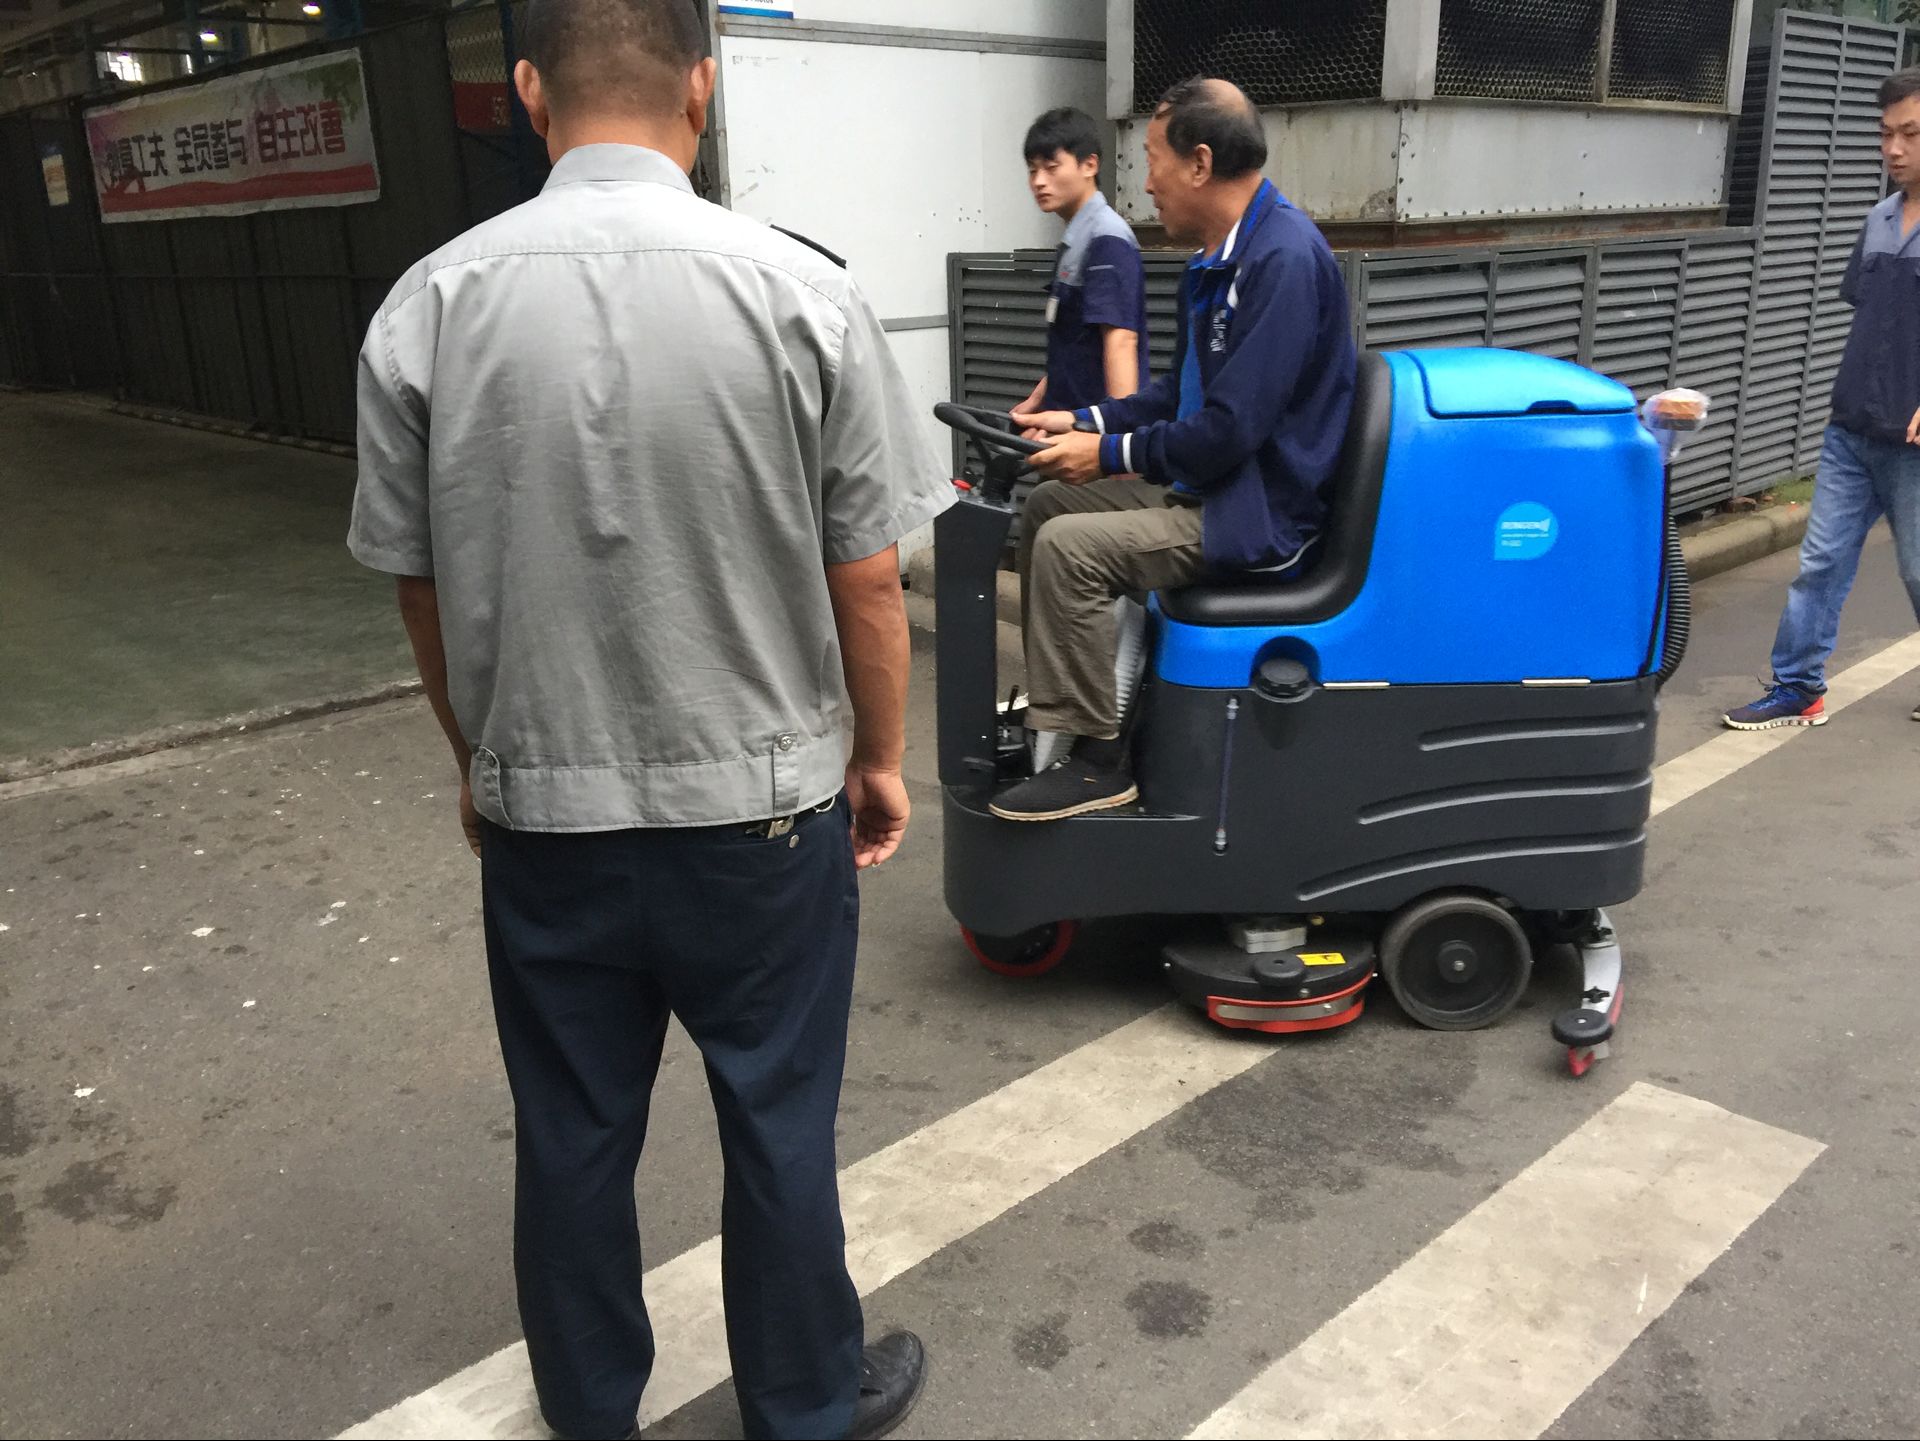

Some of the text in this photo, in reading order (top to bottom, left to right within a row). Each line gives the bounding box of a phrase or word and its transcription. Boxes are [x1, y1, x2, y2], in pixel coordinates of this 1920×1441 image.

[174, 119, 248, 174] 全员参与
[255, 100, 346, 163] 自主改善
